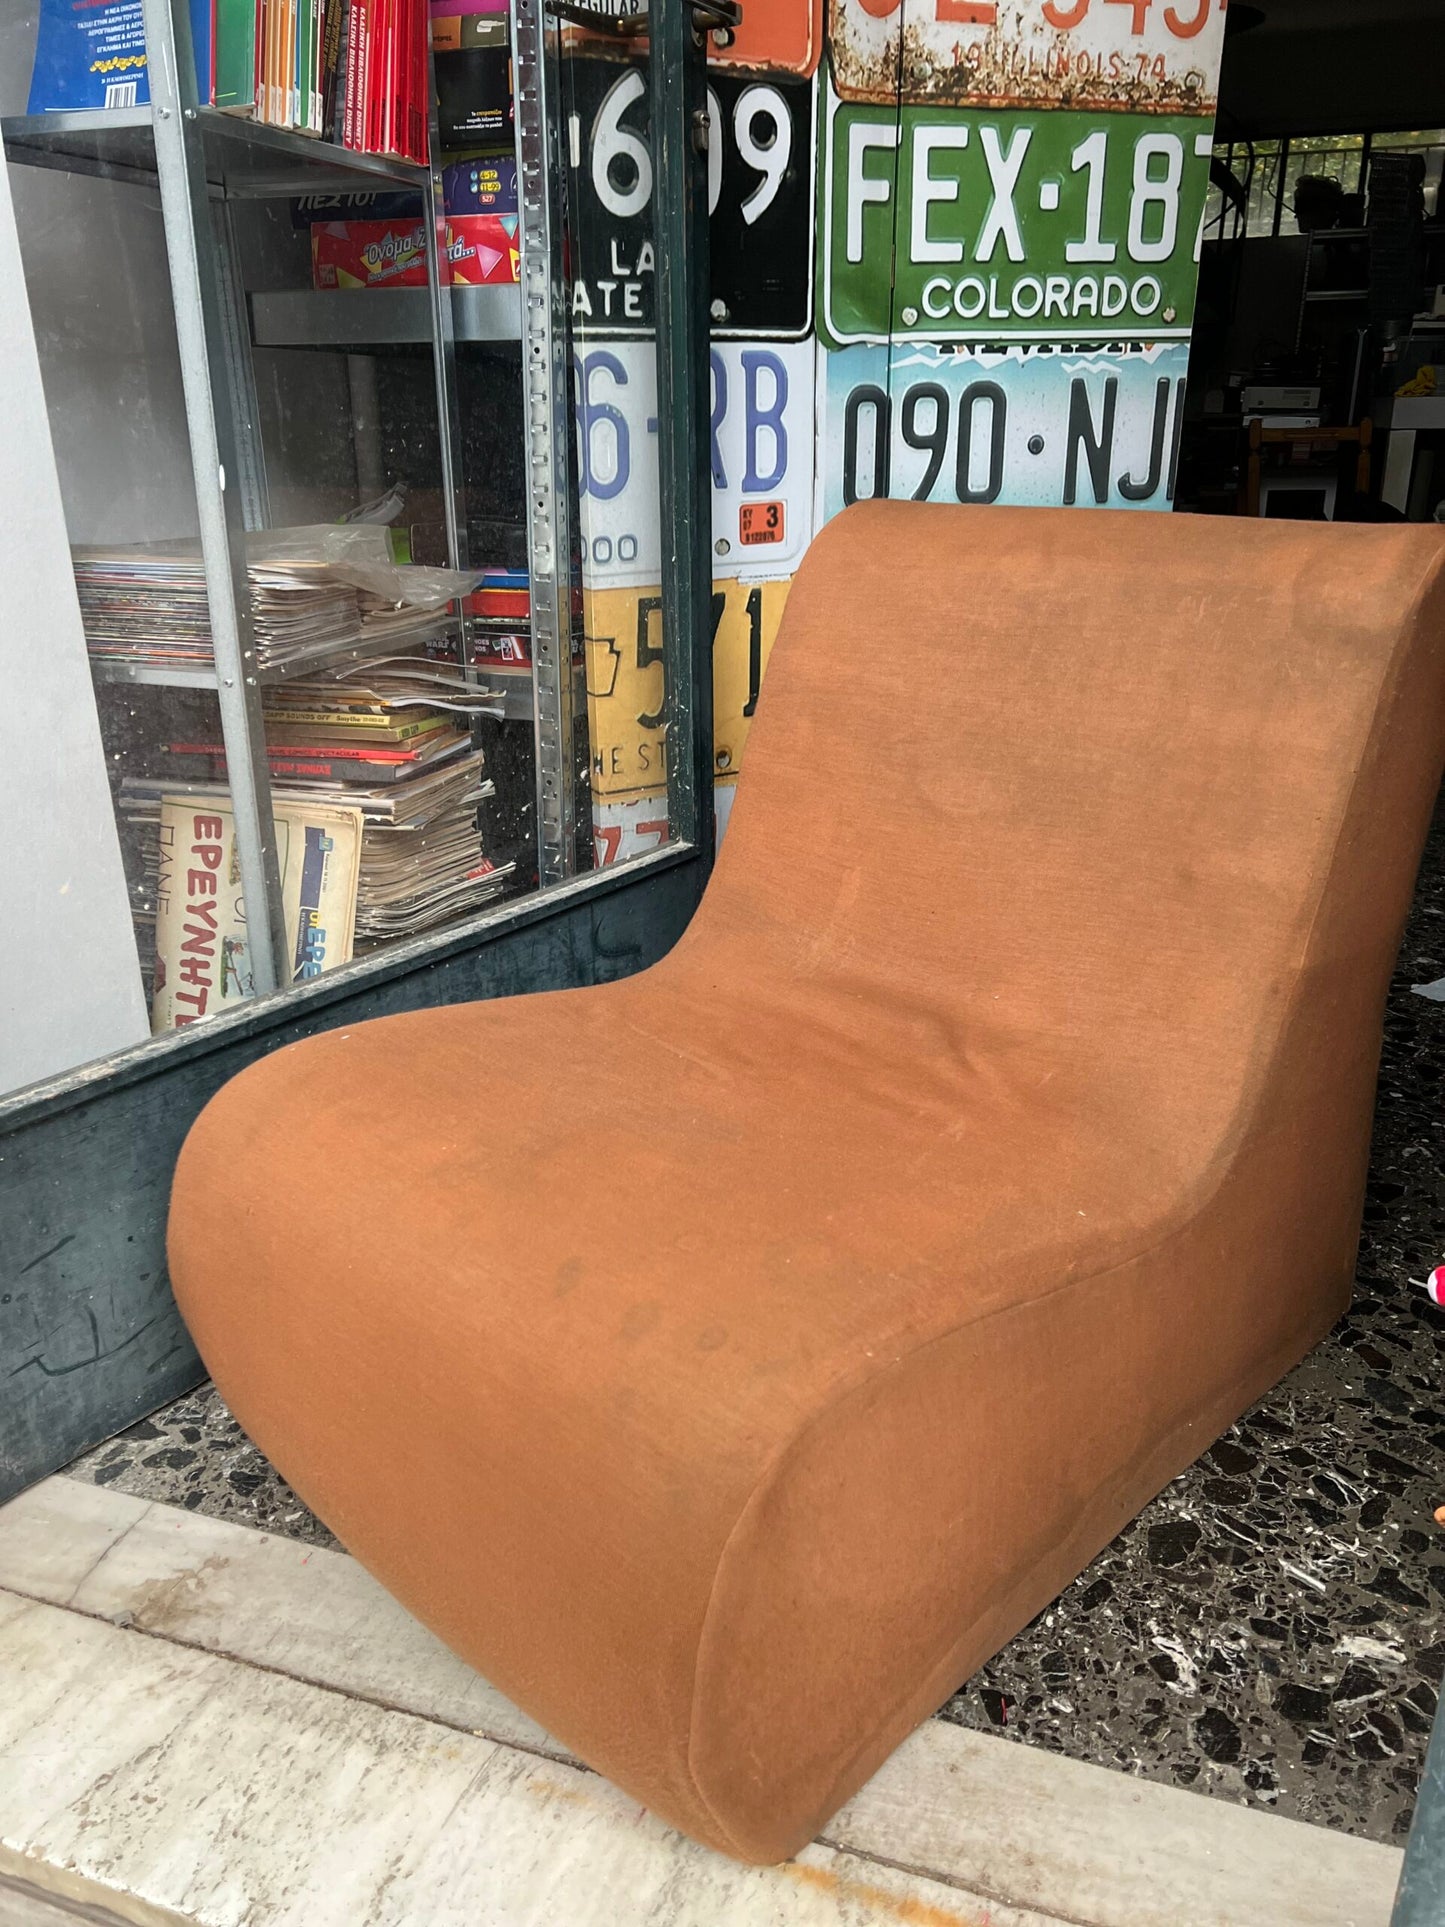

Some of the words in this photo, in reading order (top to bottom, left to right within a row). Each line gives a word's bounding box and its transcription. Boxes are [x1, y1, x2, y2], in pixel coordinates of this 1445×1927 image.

[345, 109, 353, 144] DISNEY
[354, 110, 362, 145] DISNEY
[921, 275, 1162, 319] COLORADO
[767, 505, 778, 528] 3
